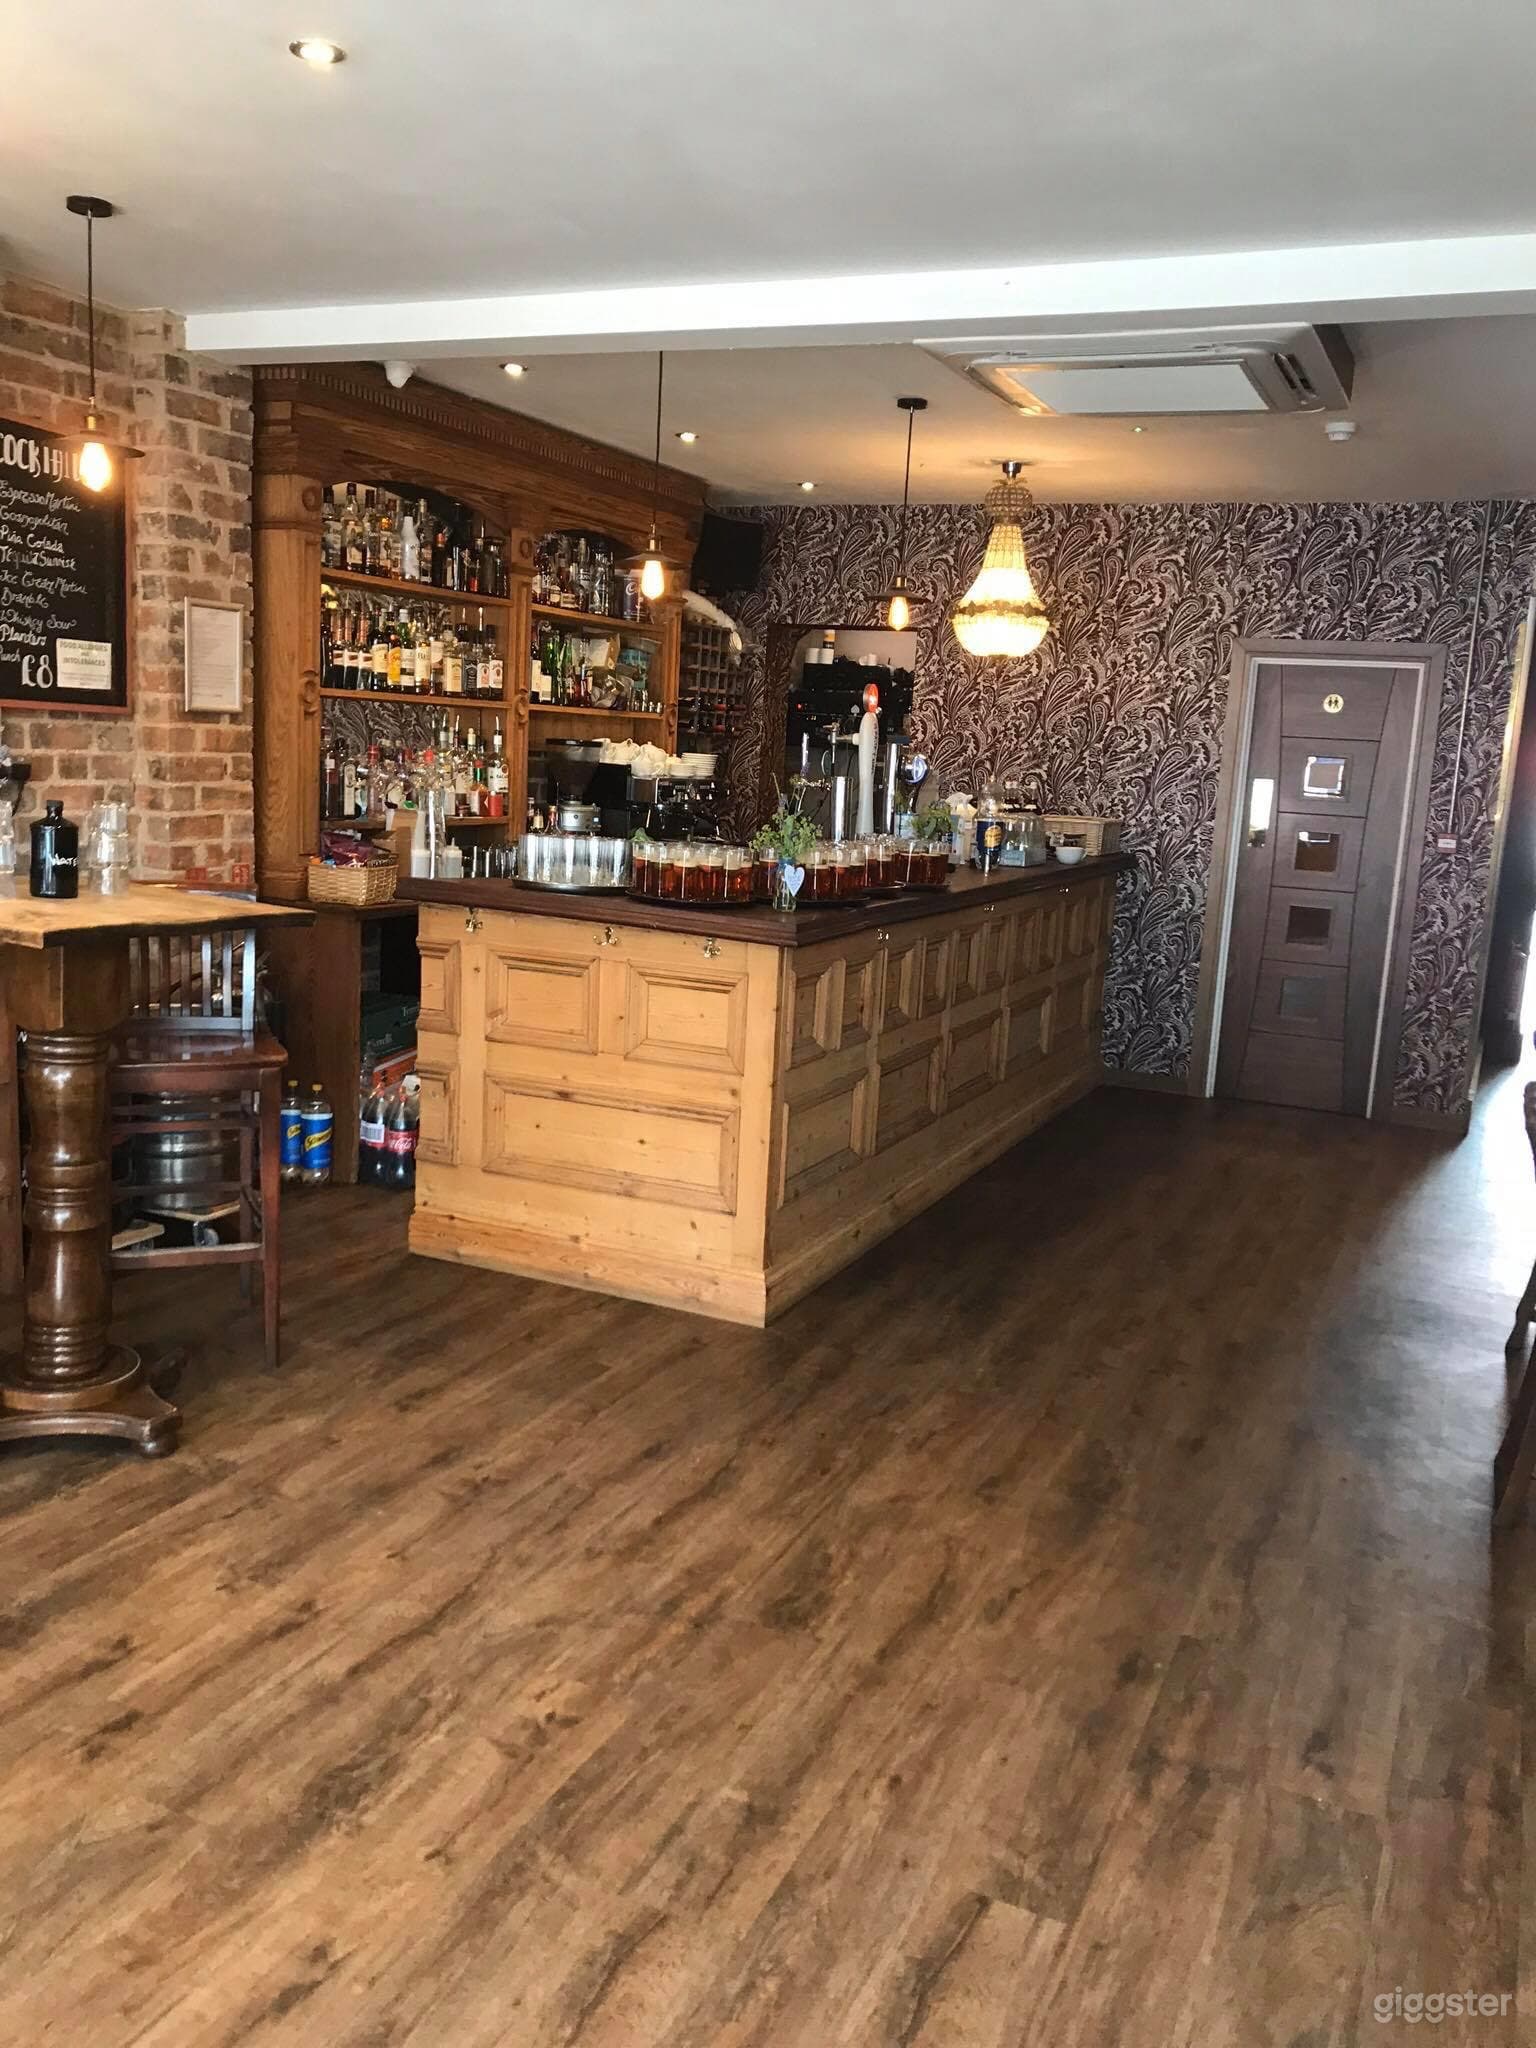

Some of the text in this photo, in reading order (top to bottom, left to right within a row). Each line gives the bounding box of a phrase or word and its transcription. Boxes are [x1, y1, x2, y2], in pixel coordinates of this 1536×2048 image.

[0, 432, 81, 483] OCKTAIL
[26, 533, 65, 554] Colada
[46, 614, 77, 629] Sour
